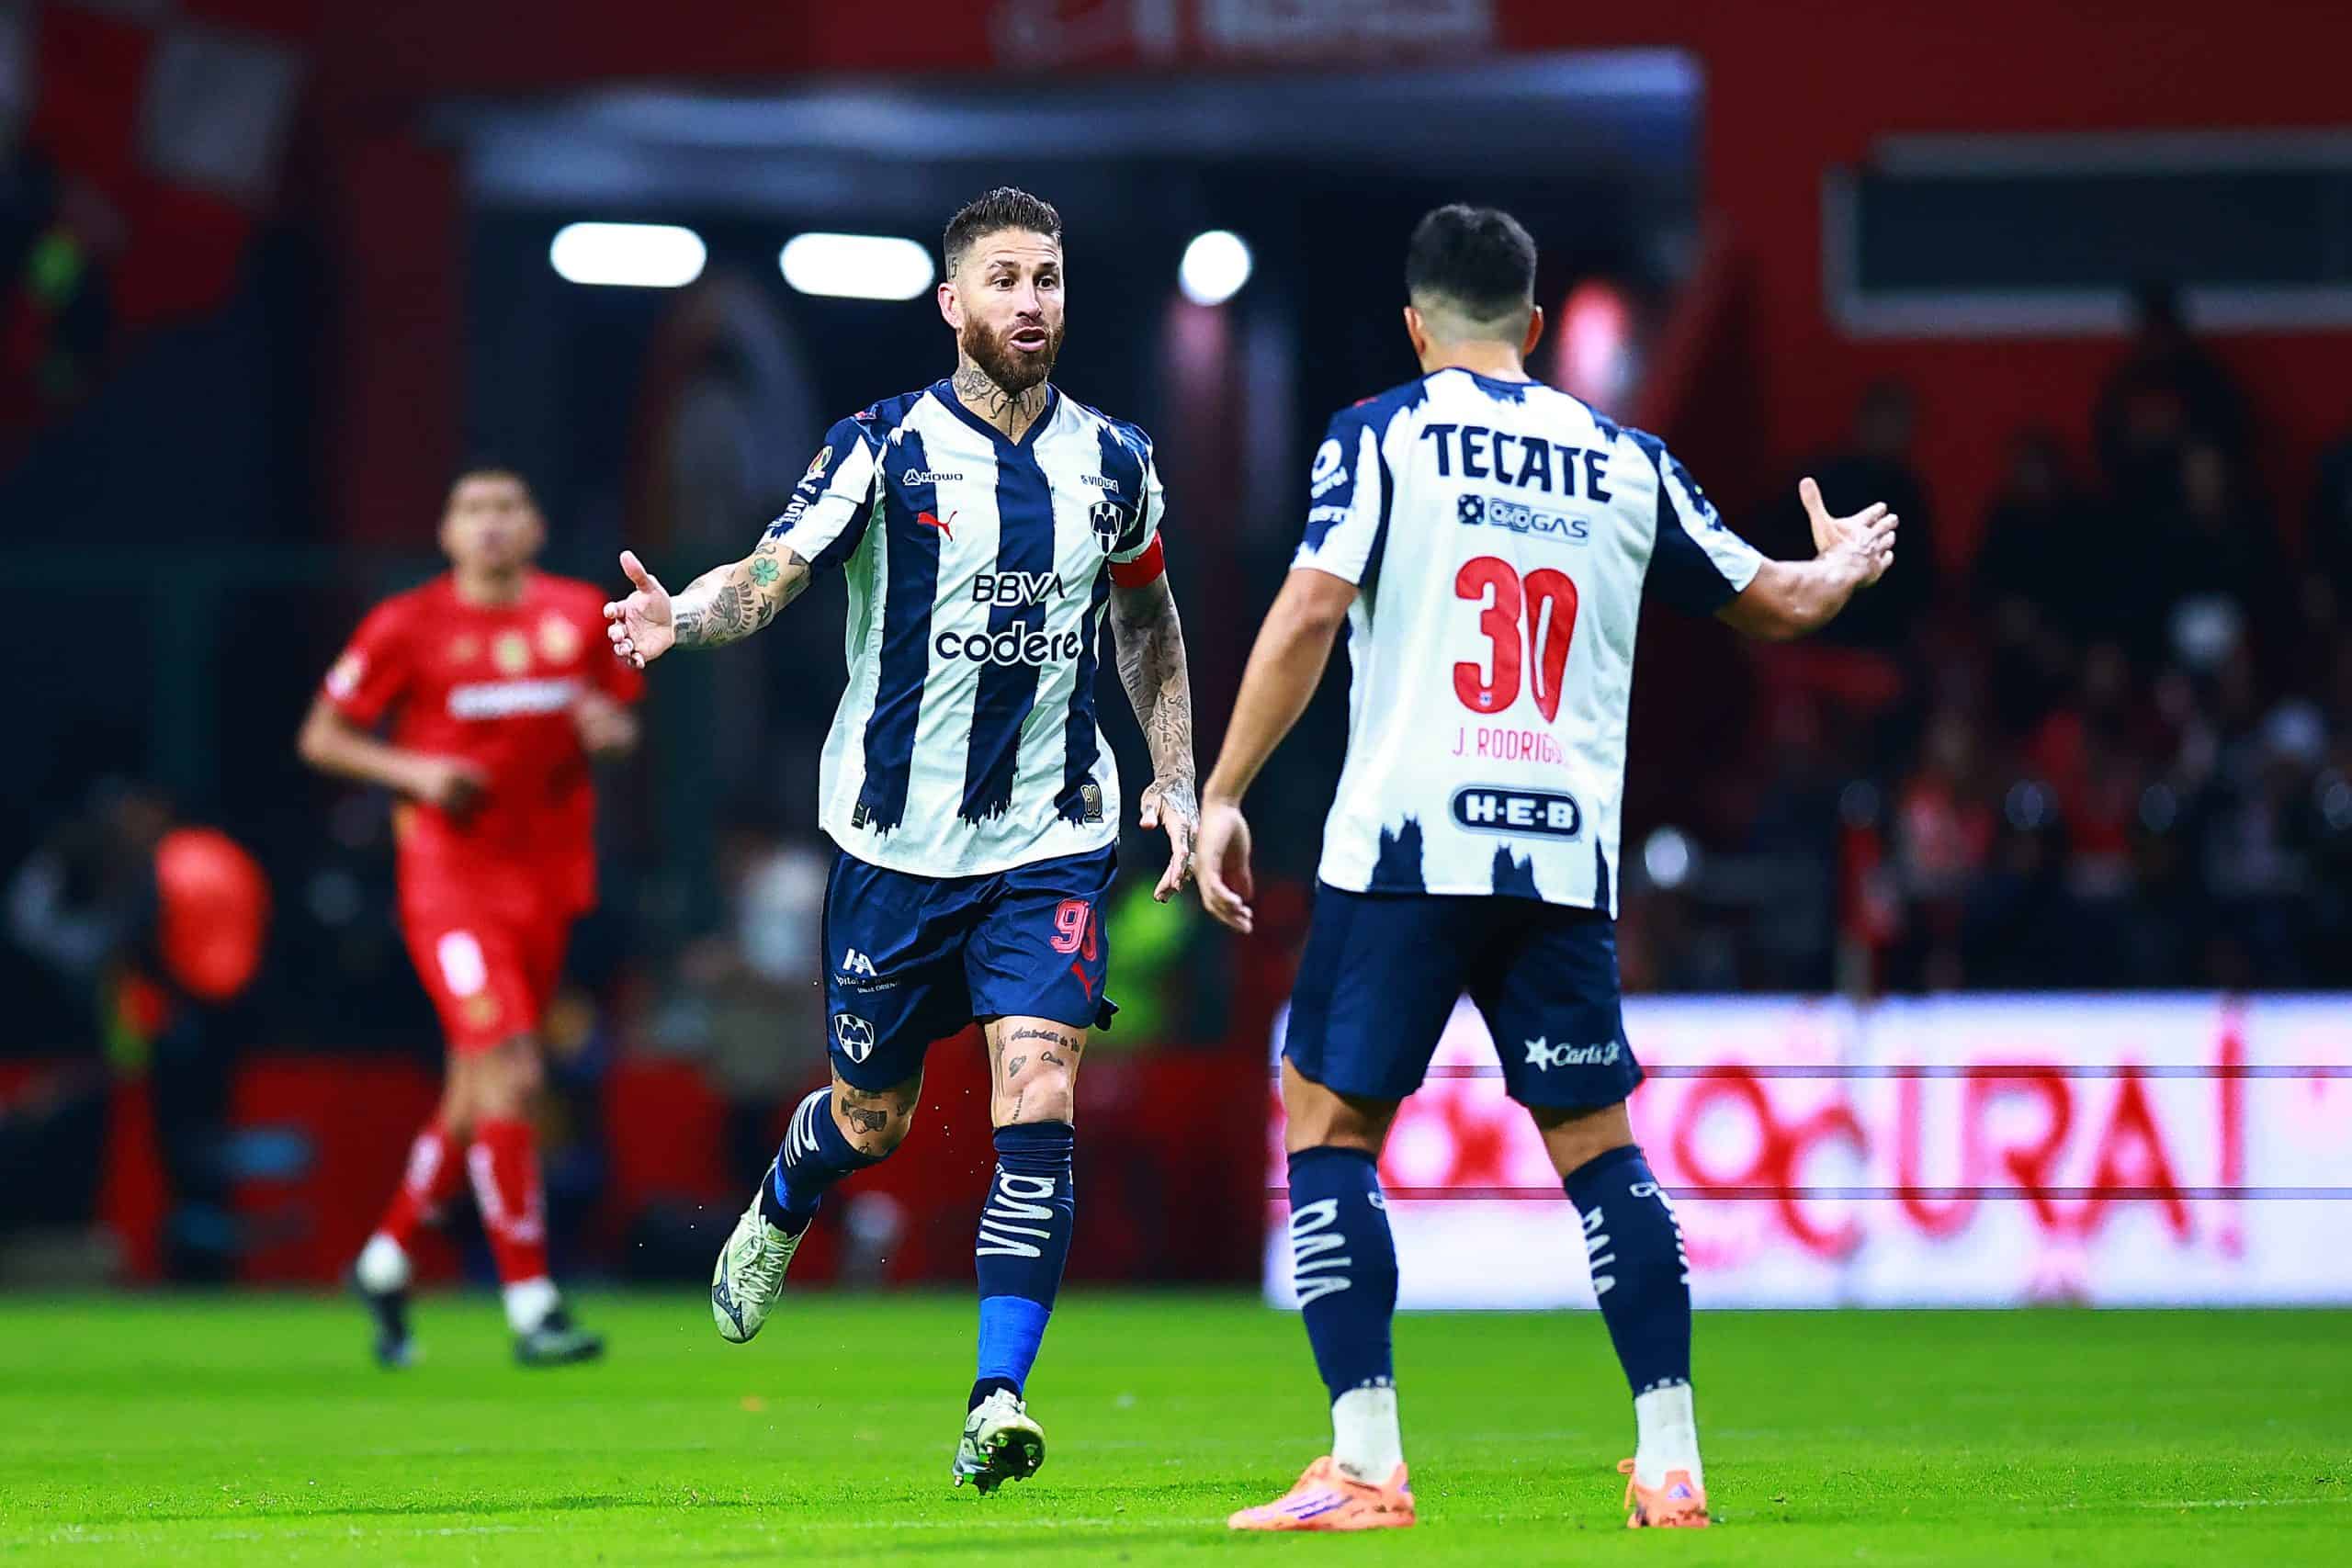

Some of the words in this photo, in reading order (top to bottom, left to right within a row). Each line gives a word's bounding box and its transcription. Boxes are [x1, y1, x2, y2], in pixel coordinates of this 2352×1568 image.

[920, 471, 964, 483] HOWO
[1420, 423, 1613, 503] TECATE
[971, 571, 1067, 606] BBVA
[934, 620, 1082, 666] codere
[1453, 556, 1579, 725] 30
[1452, 727, 1470, 757] J.
[1477, 728, 1566, 764] RODRIG
